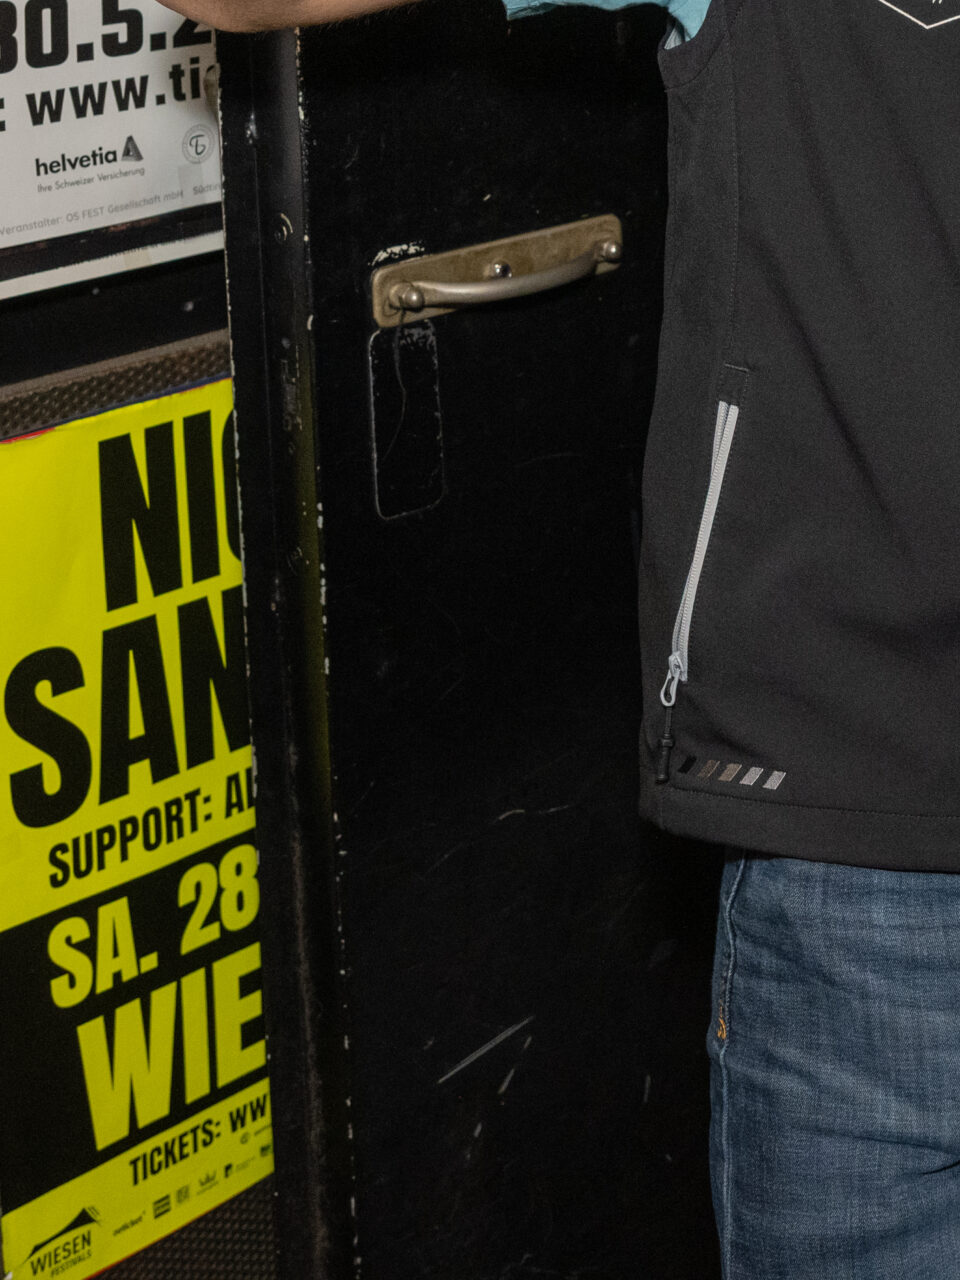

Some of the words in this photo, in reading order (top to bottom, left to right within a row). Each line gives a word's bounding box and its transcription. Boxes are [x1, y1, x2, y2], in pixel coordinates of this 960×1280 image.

[26, 56, 216, 127] www.ti
[35, 146, 118, 177] helvetia
[37, 182, 53, 193] Ihre
[55, 176, 94, 191] Schweizer
[97, 167, 146, 183] Versicherung
[82, 206, 105, 220] FEST
[107, 194, 161, 214] Gesellschaft
[163, 190, 184, 202] mbH
[48, 788, 213, 889] SUPPORT:
[47, 895, 158, 1009] SA.
[177, 843, 260, 956] 28
[129, 1118, 221, 1187] TICKETS:
[30, 1230, 92, 1277] WIESEN
[50, 1250, 93, 1280] FESTIVALS
